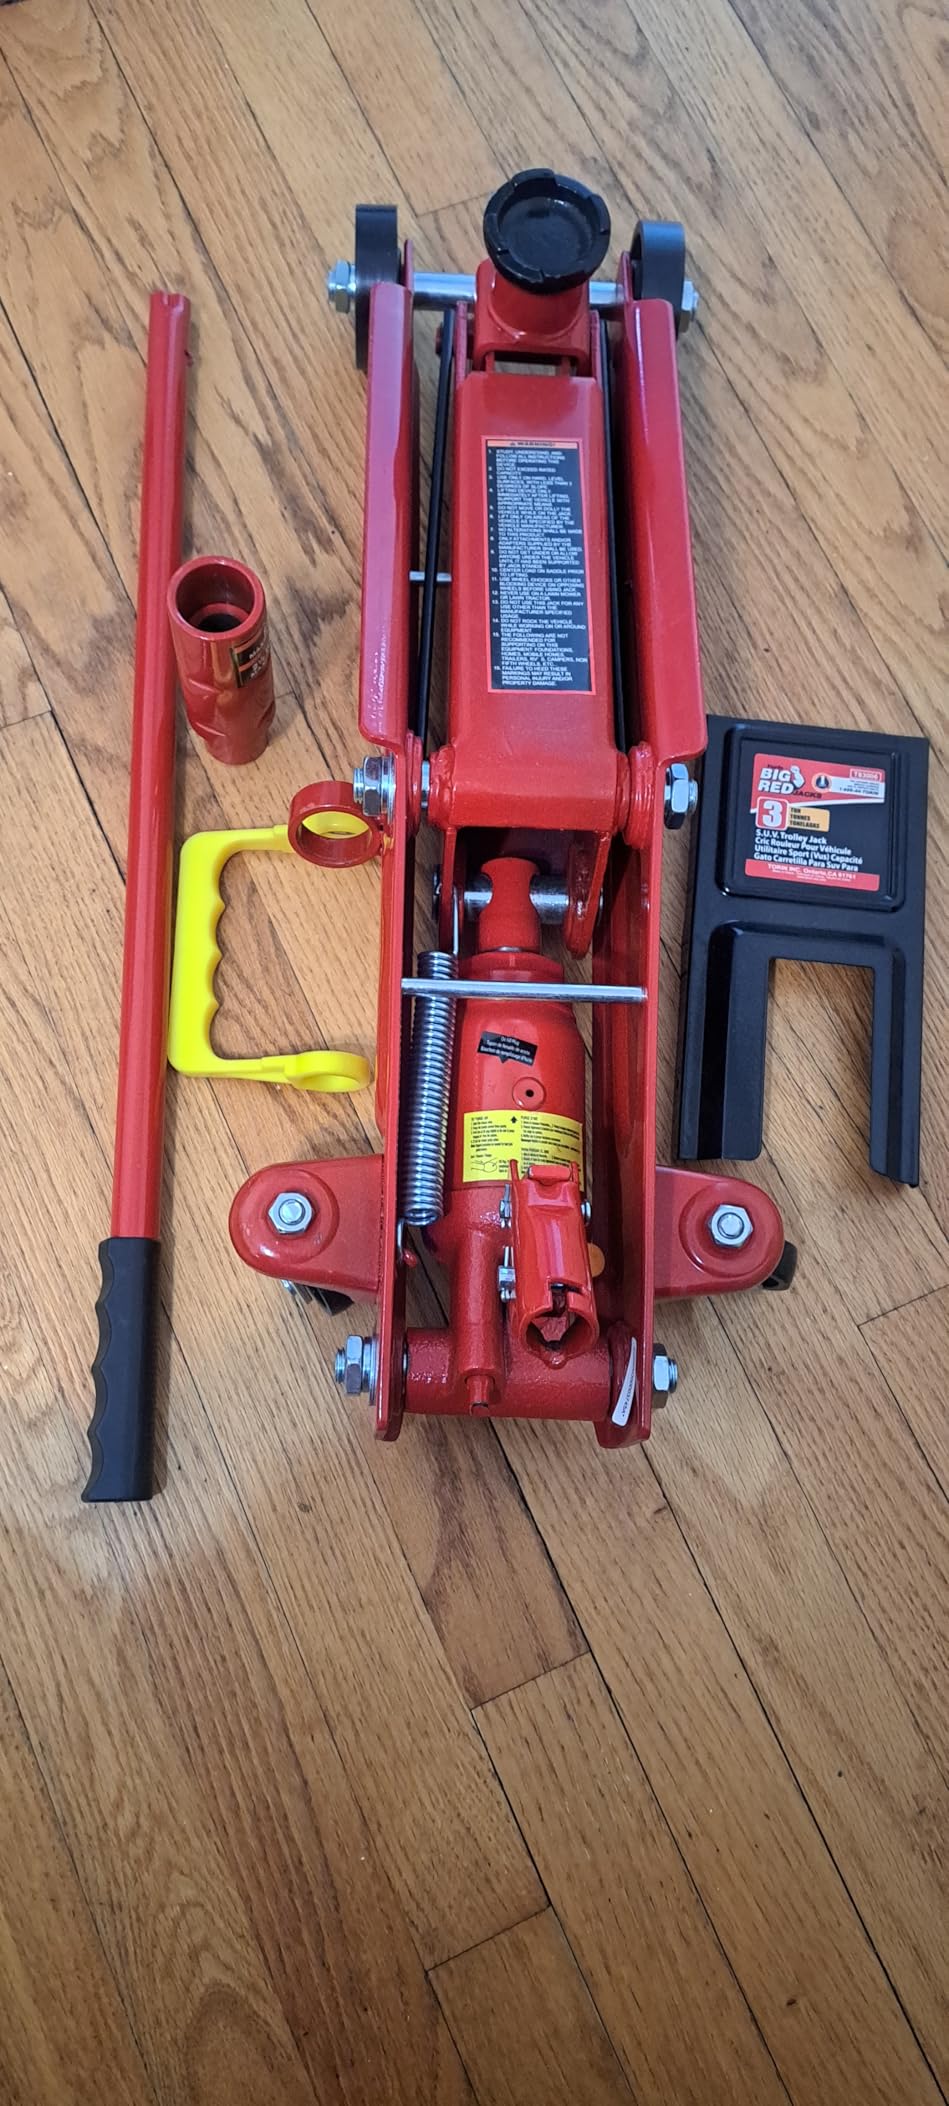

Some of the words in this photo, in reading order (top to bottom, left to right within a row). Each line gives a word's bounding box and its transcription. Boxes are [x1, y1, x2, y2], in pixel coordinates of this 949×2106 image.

[760, 768, 790, 781] BIG
[758, 780, 794, 794] RED
[792, 790, 822, 798] JACKS
[762, 800, 782, 827] 3
[756, 829, 780, 839] S.U.V.
[780, 832, 808, 842] Trolley
[809, 836, 827, 844] Jack
[755, 837, 769, 845] Cric
[770, 839, 800, 849] Rouleur
[801, 842, 819, 850] Pour
[820, 845, 851, 855] Véhicule
[754, 852, 772, 861] Gato
[773, 855, 807, 865] Carretilla
[808, 859, 825, 867] Para
[842, 863, 858, 872] Para
[755, 845, 787, 855] Utilitaire
[789, 849, 810, 858] Sport
[810, 851, 829, 861] (Vus)
[830, 854, 862, 864] Capacité
